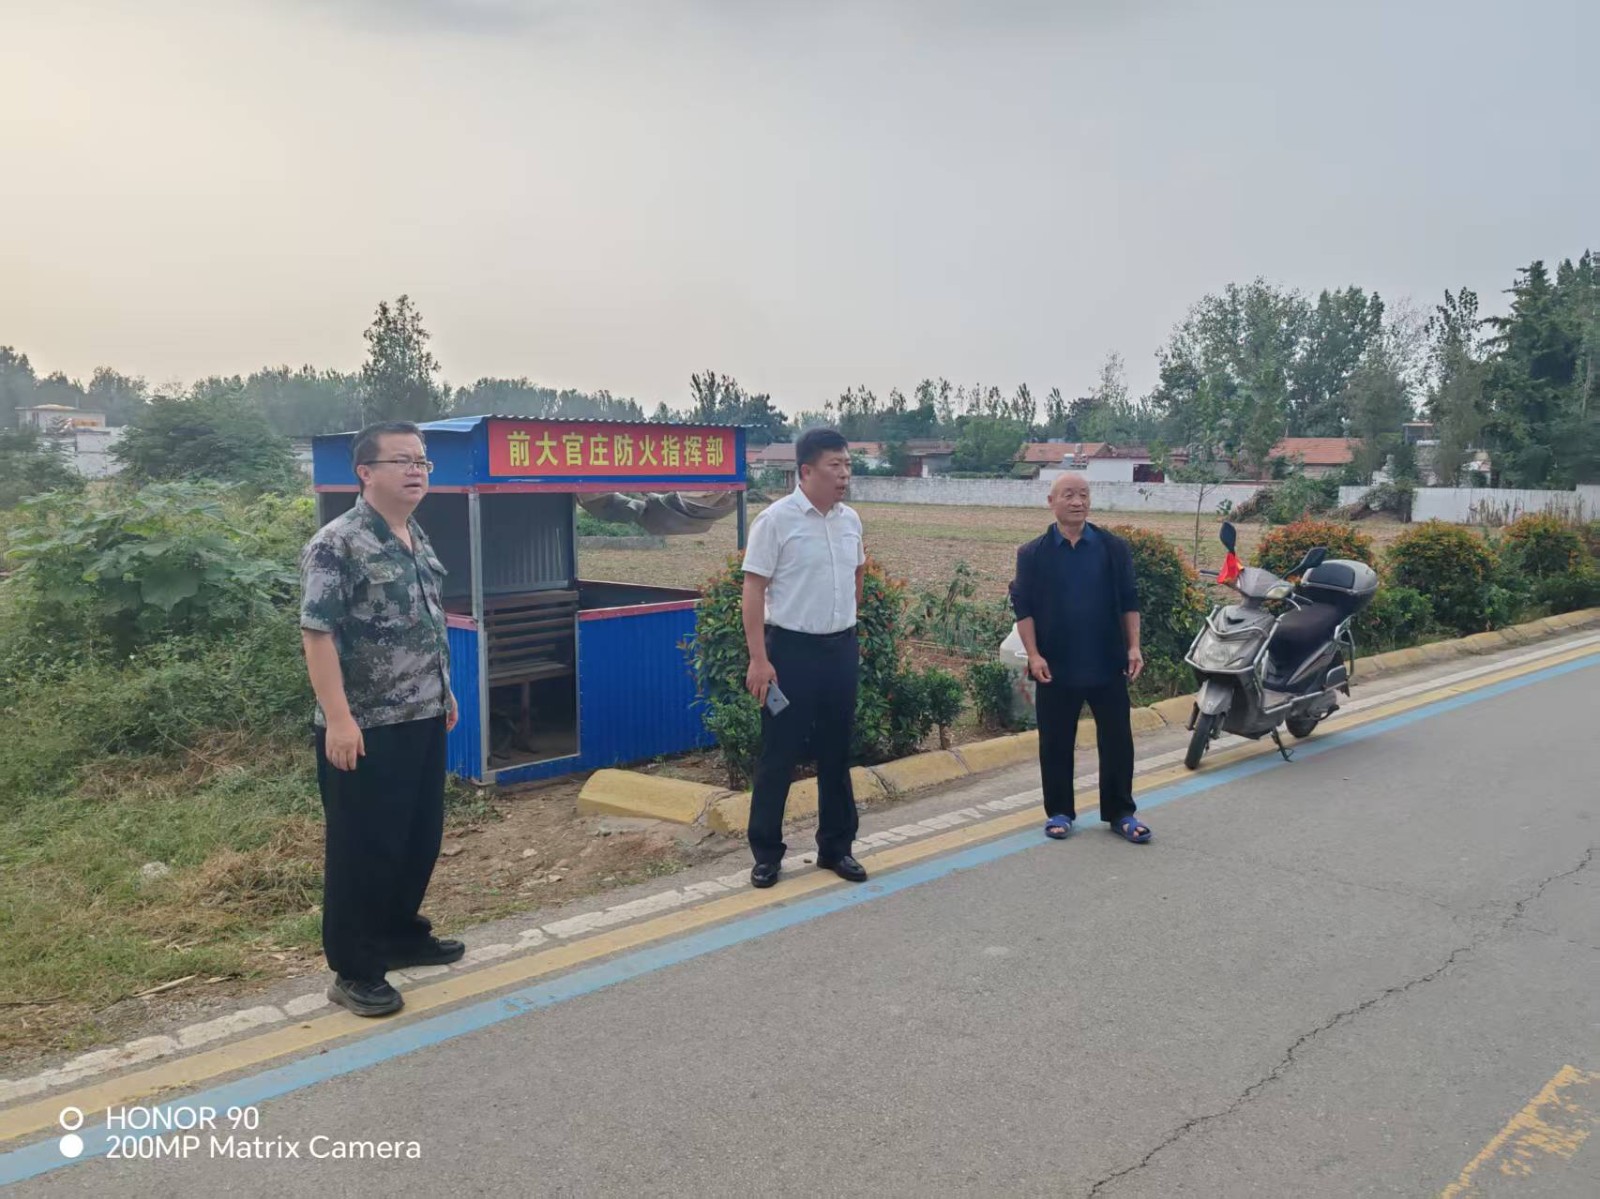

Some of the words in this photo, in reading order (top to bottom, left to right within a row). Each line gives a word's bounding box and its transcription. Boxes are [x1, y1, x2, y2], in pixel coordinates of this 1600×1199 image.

[507, 431, 724, 467] 前大官庄防火指挥部
